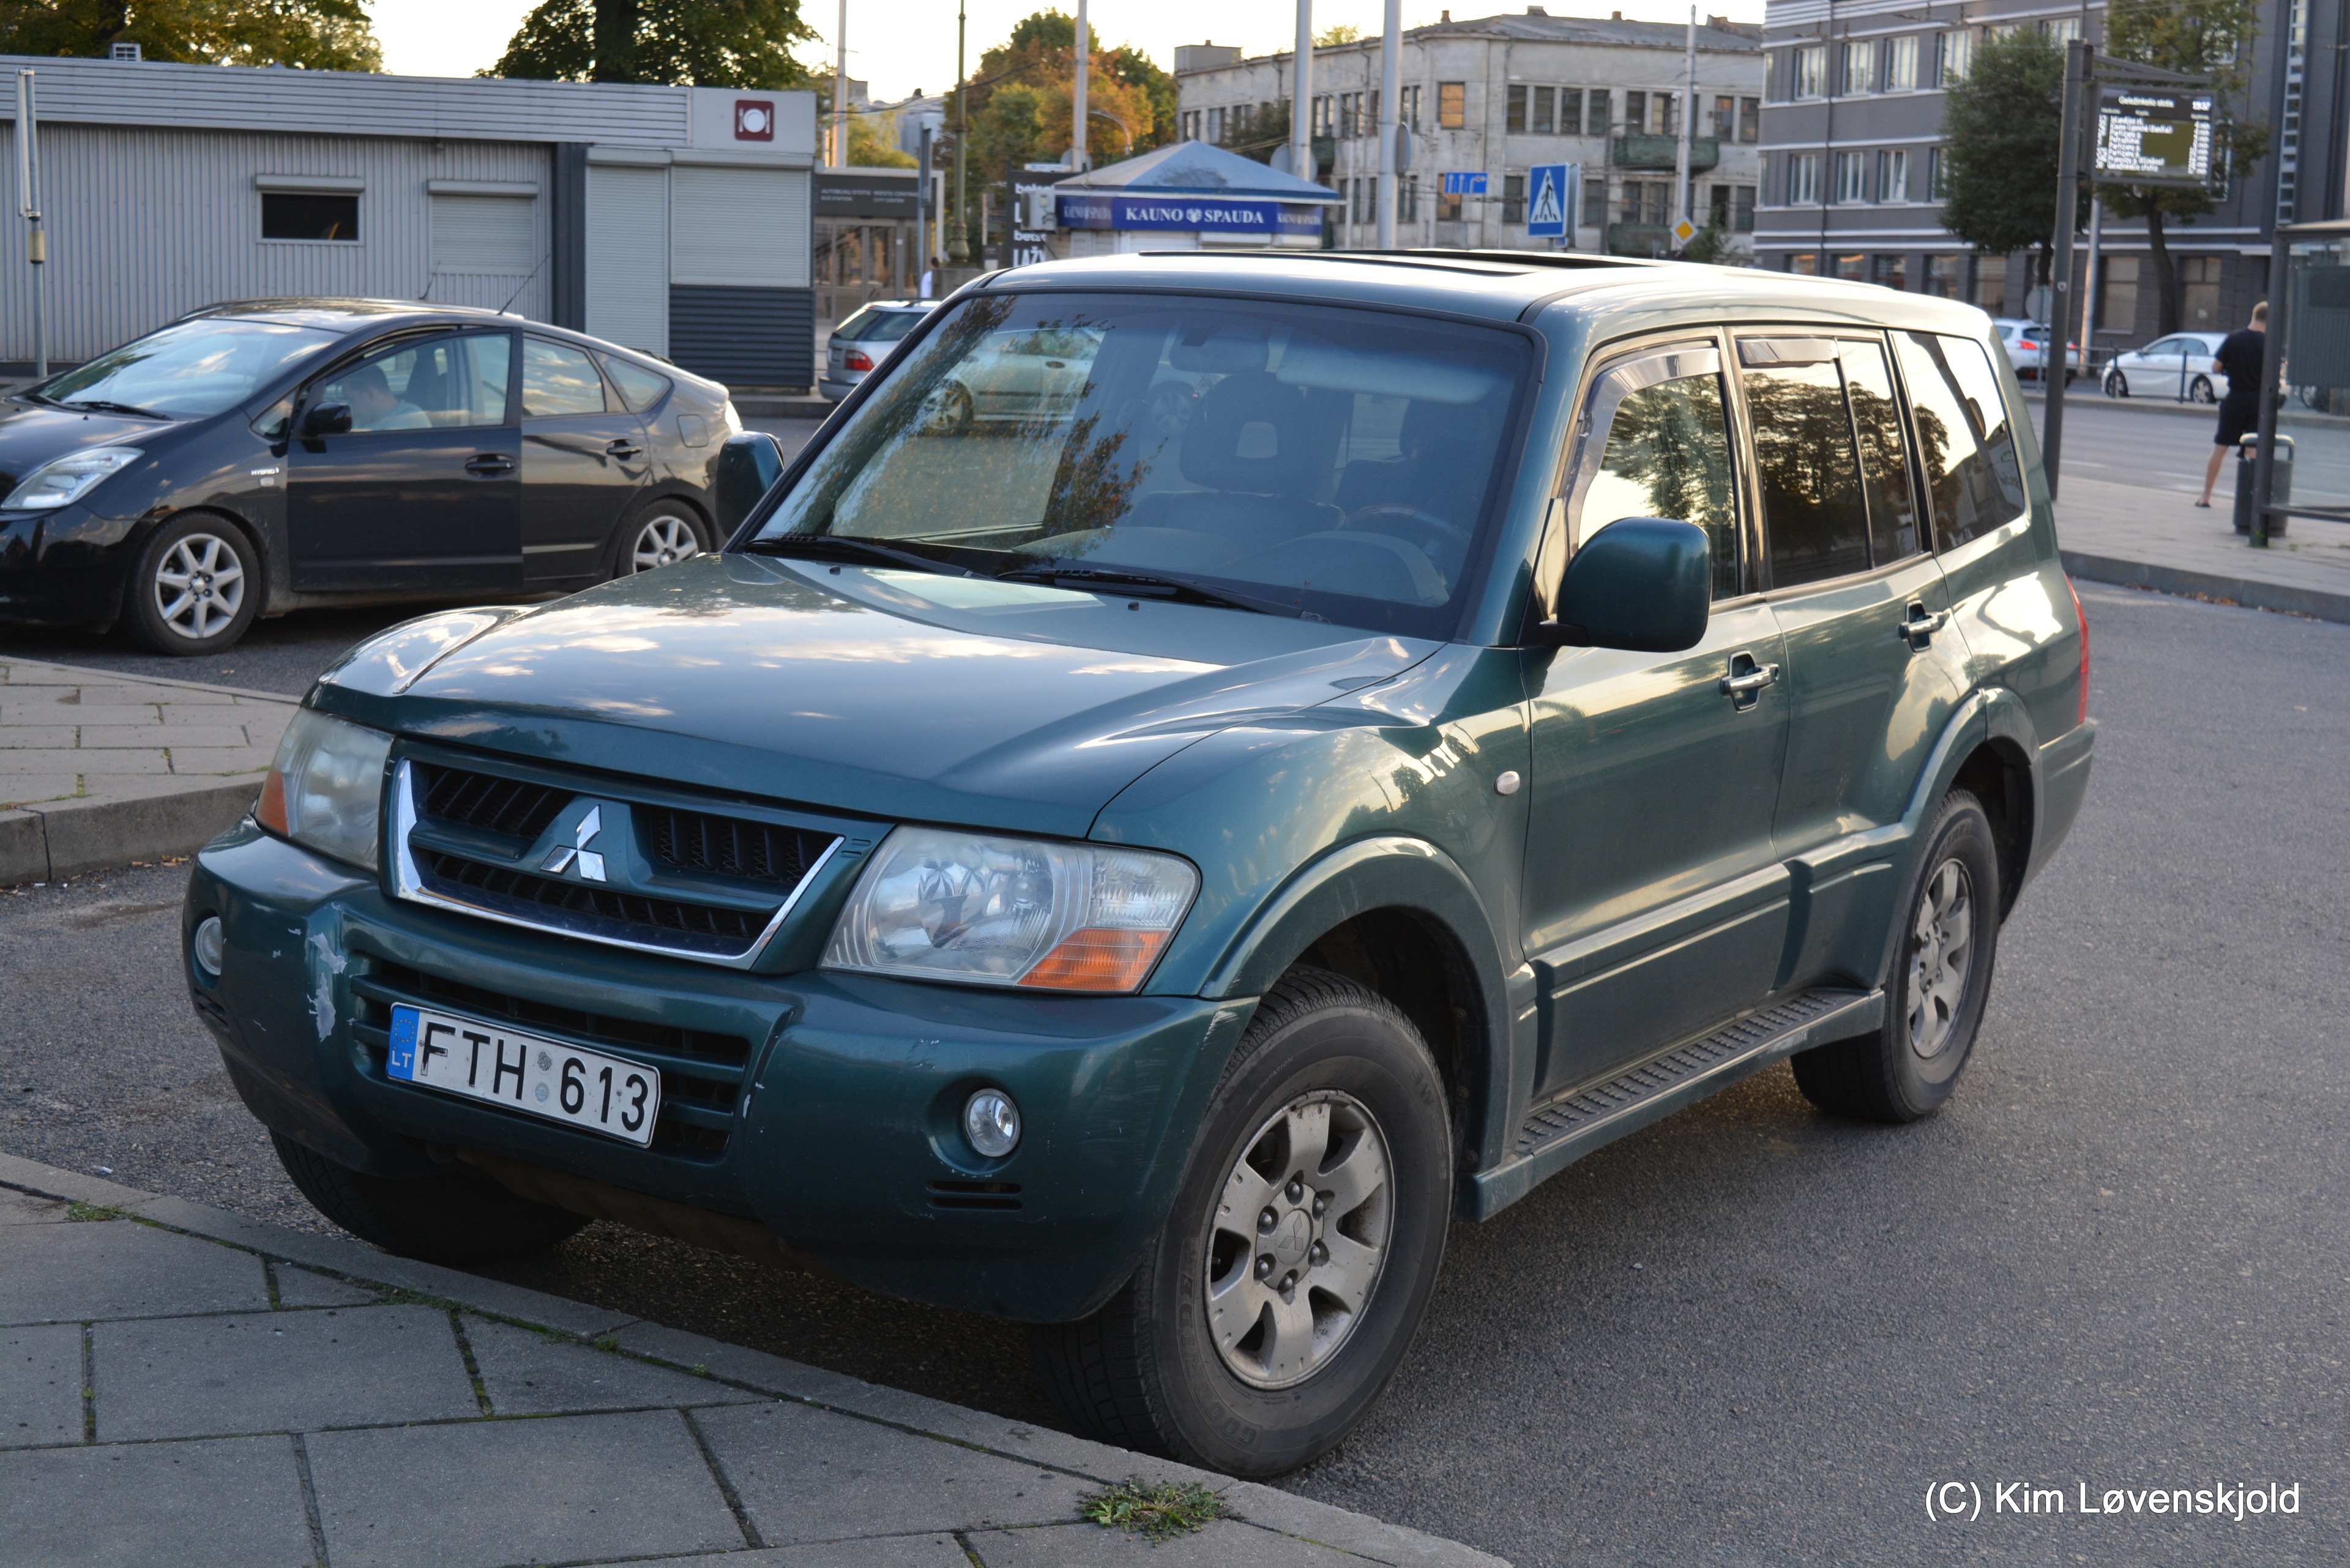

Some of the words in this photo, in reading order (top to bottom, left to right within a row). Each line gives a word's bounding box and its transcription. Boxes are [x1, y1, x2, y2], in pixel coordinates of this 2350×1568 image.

[1125, 207, 1184, 222] KAUNO
[1204, 209, 1264, 224] SPAUDA
[391, 1049, 412, 1068] LT
[420, 1021, 528, 1100] FTH
[559, 1056, 649, 1132] 613
